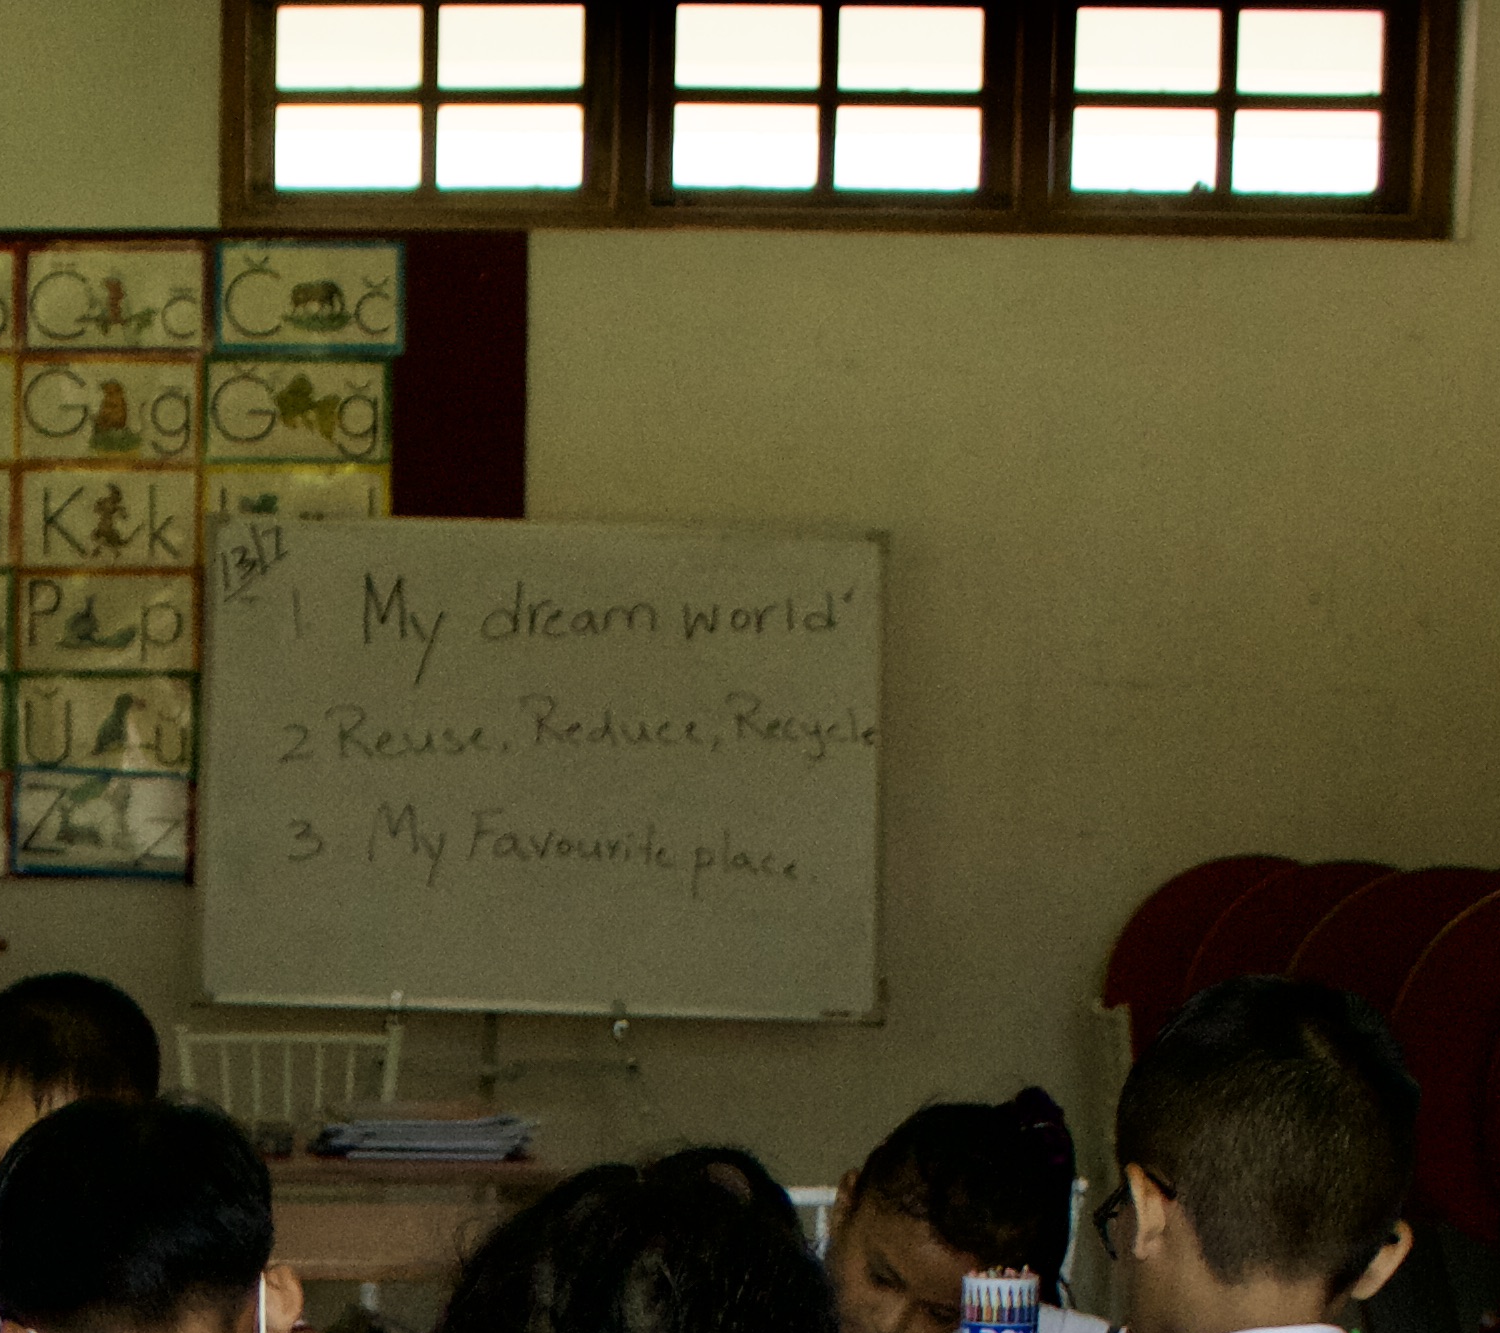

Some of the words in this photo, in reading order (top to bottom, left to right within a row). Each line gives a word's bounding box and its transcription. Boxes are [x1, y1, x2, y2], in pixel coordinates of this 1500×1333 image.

[363, 572, 445, 685] My
[480, 580, 656, 641] dream
[280, 721, 313, 764] 2
[723, 689, 876, 761] Recycle
[287, 818, 324, 863] 3
[367, 800, 446, 889] My
[468, 806, 673, 871] Favourite
